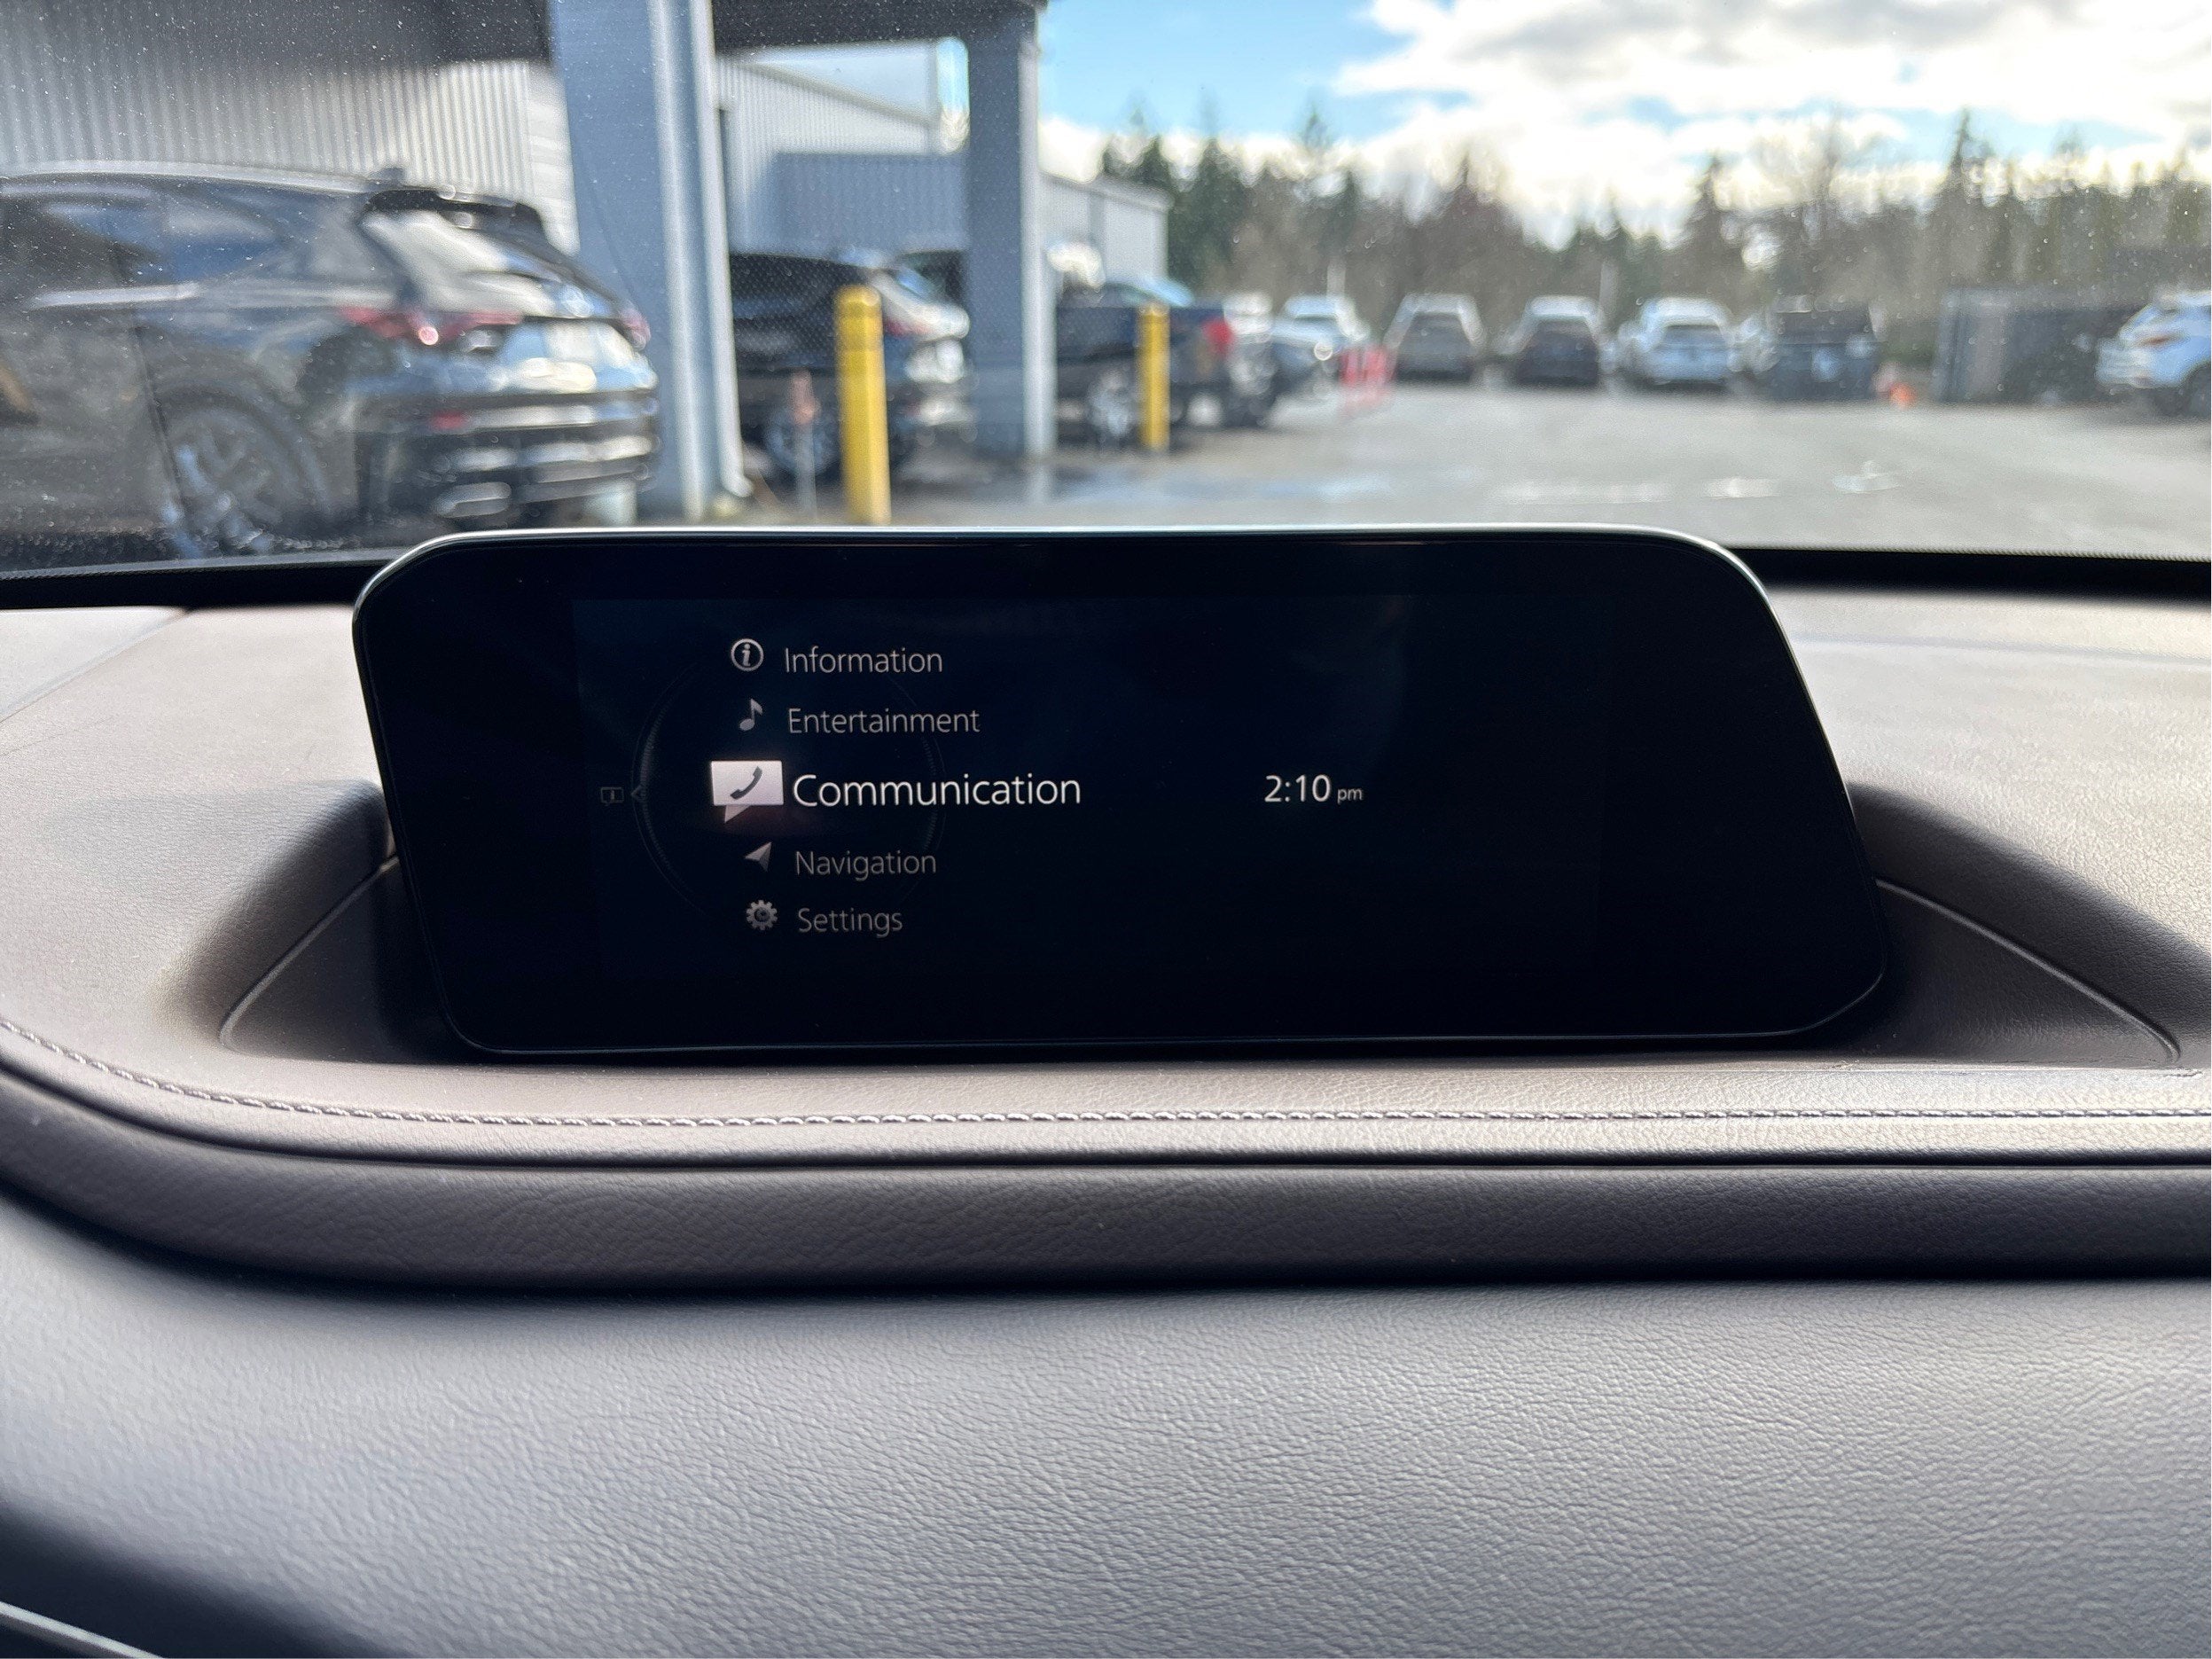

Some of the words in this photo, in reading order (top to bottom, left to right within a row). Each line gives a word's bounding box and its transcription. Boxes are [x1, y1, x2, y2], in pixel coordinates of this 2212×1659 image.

[785, 646, 943, 674] Information
[788, 707, 981, 735] Entertainment
[793, 772, 1081, 807] Communication
[1263, 773, 1332, 802] 2:10
[1337, 787, 1364, 804] pm
[795, 849, 937, 882] Navigation
[797, 907, 903, 938] Settings
